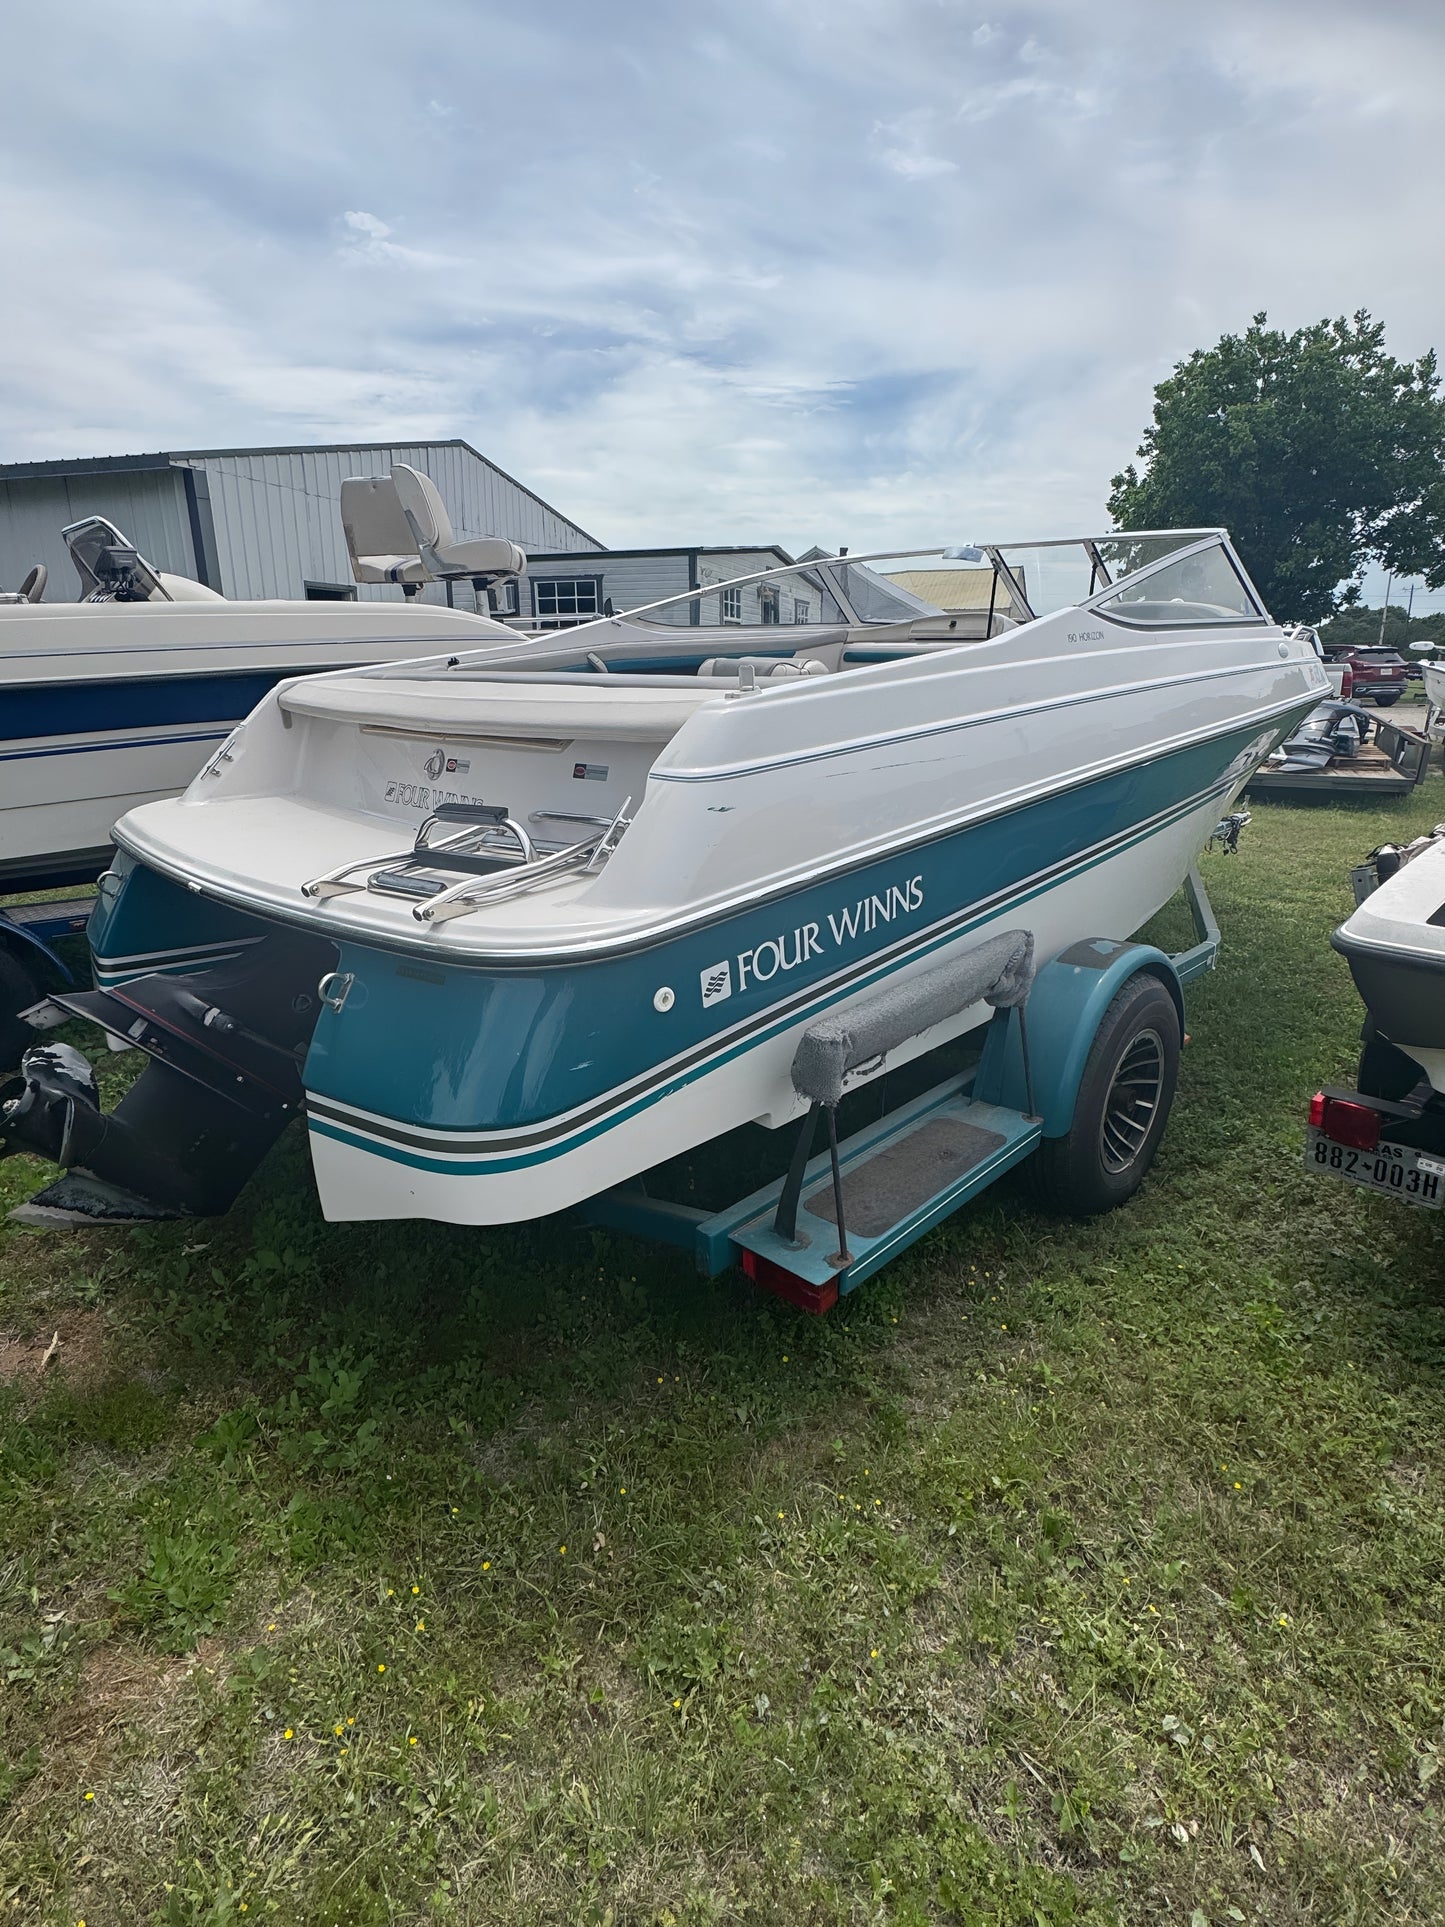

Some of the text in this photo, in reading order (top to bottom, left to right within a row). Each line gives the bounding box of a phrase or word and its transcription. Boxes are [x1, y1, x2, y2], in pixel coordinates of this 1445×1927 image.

[1079, 631, 1105, 642] HORIZON
[396, 782, 430, 810] FOUR
[737, 875, 924, 992] FOUR WINNS
